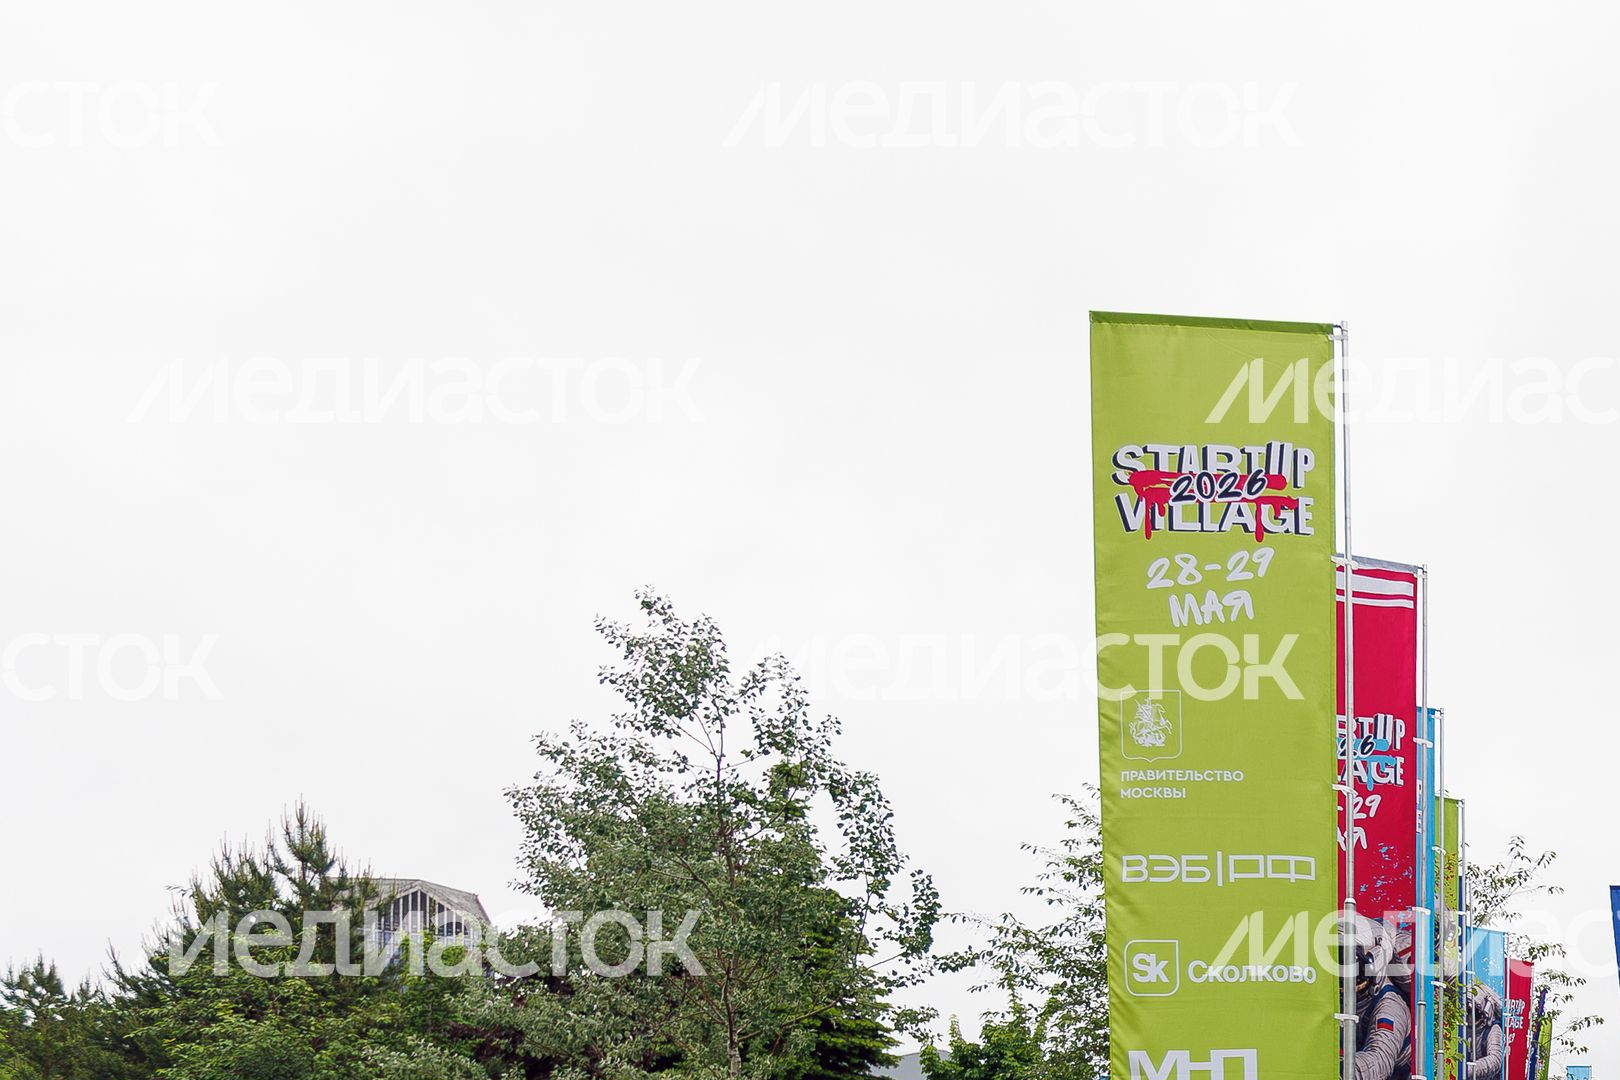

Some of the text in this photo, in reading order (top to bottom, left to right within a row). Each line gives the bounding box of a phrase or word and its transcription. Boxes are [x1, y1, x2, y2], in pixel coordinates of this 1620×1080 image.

[1111, 441, 1315, 489] STARTUP
[1170, 469, 1268, 502] 2026
[1115, 492, 1315, 536] VILLAGE
[1146, 547, 1275, 590] 28-29
[1168, 590, 1255, 628] МАЯ
[1336, 713, 1406, 750] RTUP
[1120, 769, 1244, 783] ПРАВИТЕЛЬСТВО
[1120, 787, 1187, 799] МОСКВЫ
[1131, 953, 1317, 984] Sk Сколково
